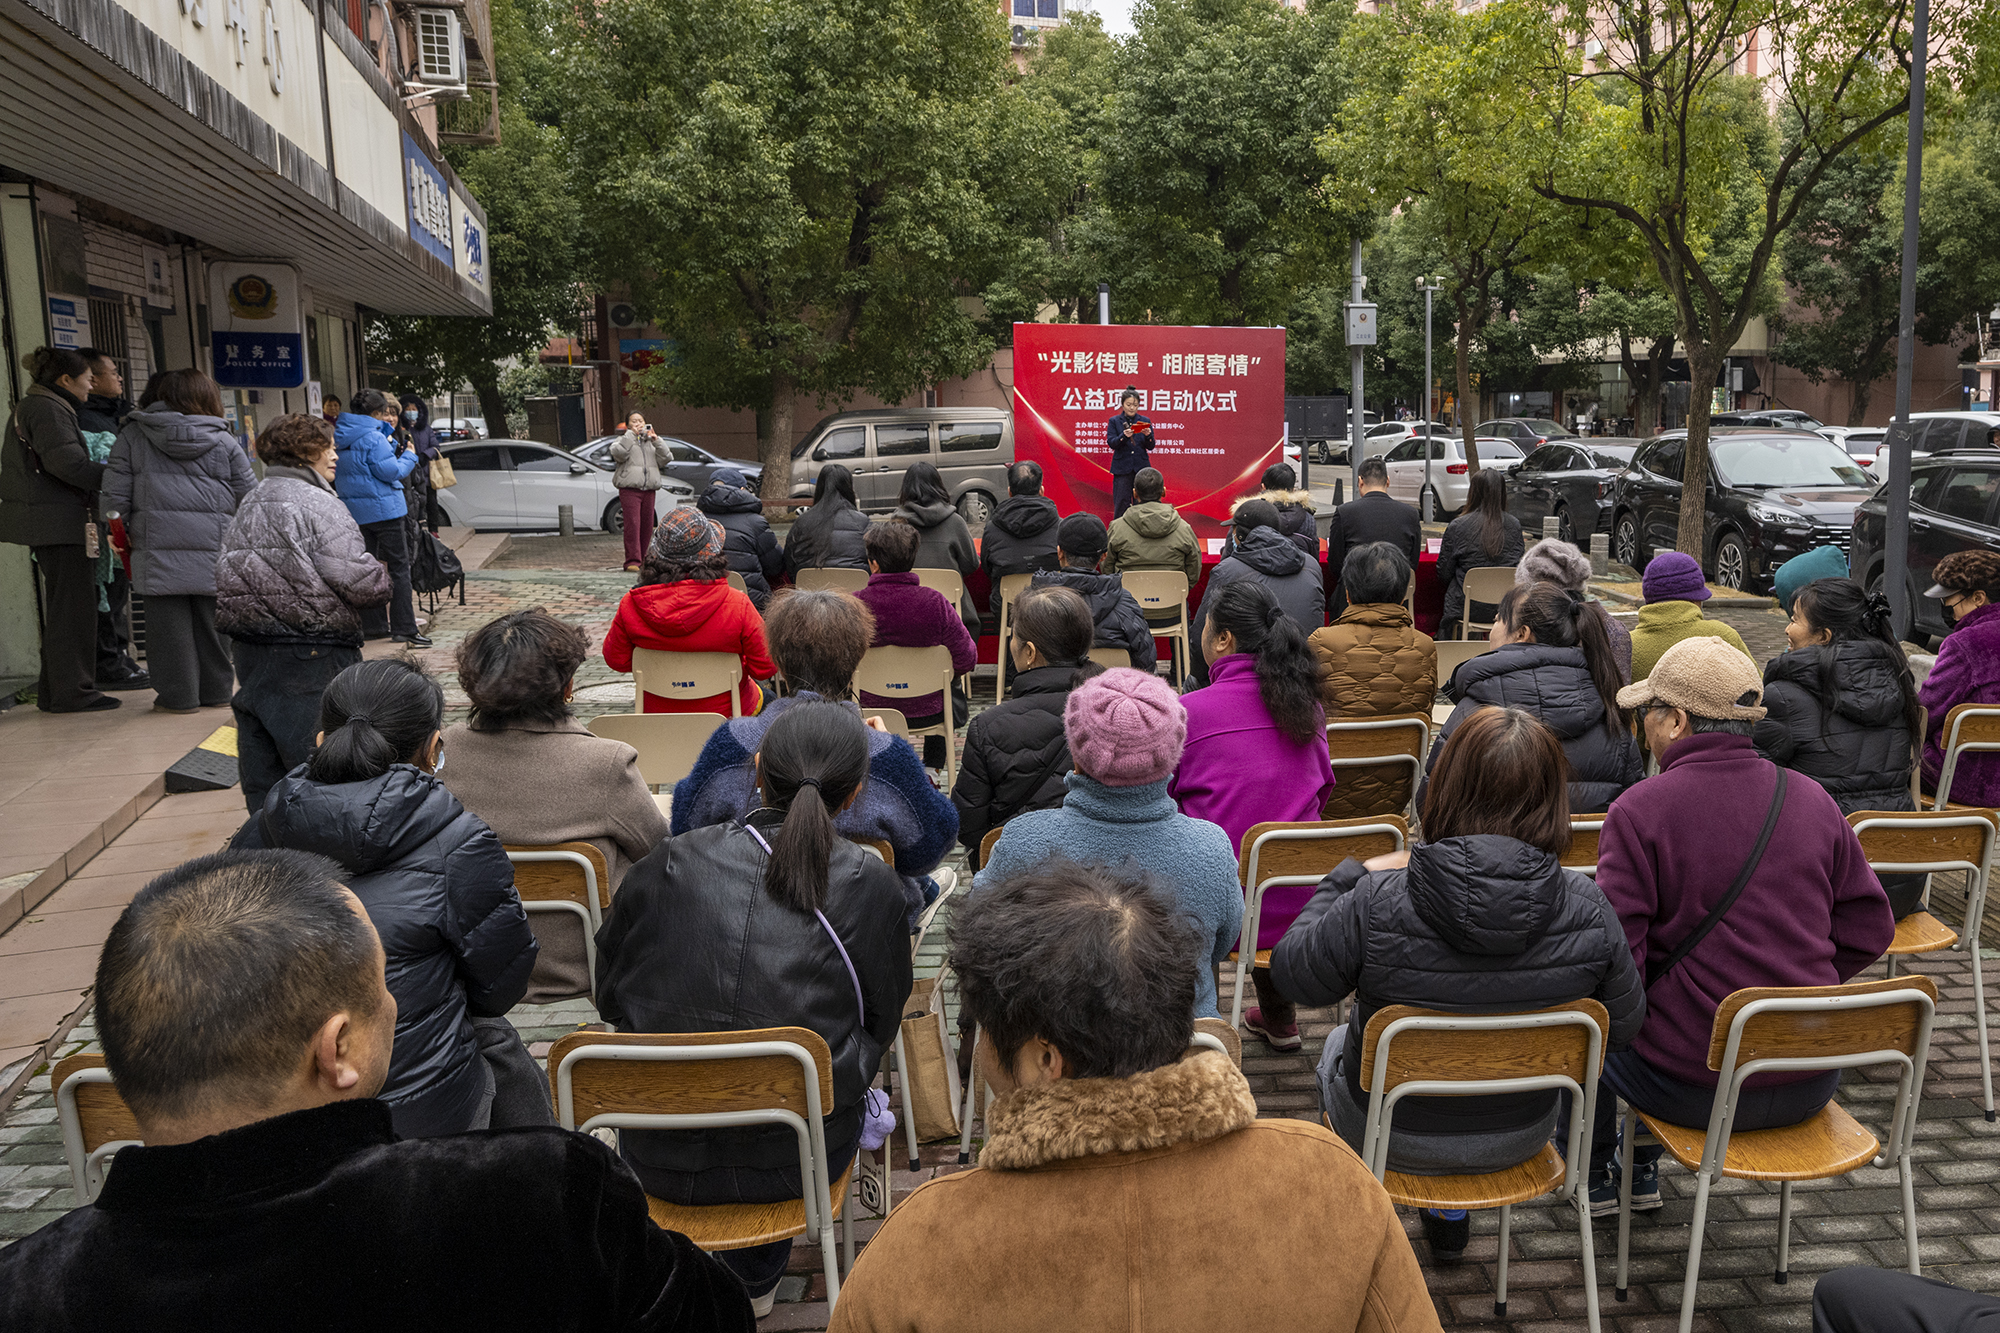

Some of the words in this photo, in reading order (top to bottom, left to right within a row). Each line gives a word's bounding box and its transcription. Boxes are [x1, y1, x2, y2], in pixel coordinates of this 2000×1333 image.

[225, 344, 290, 359] 警务室
[1062, 387, 1237, 412] 公益项目启动仪式
